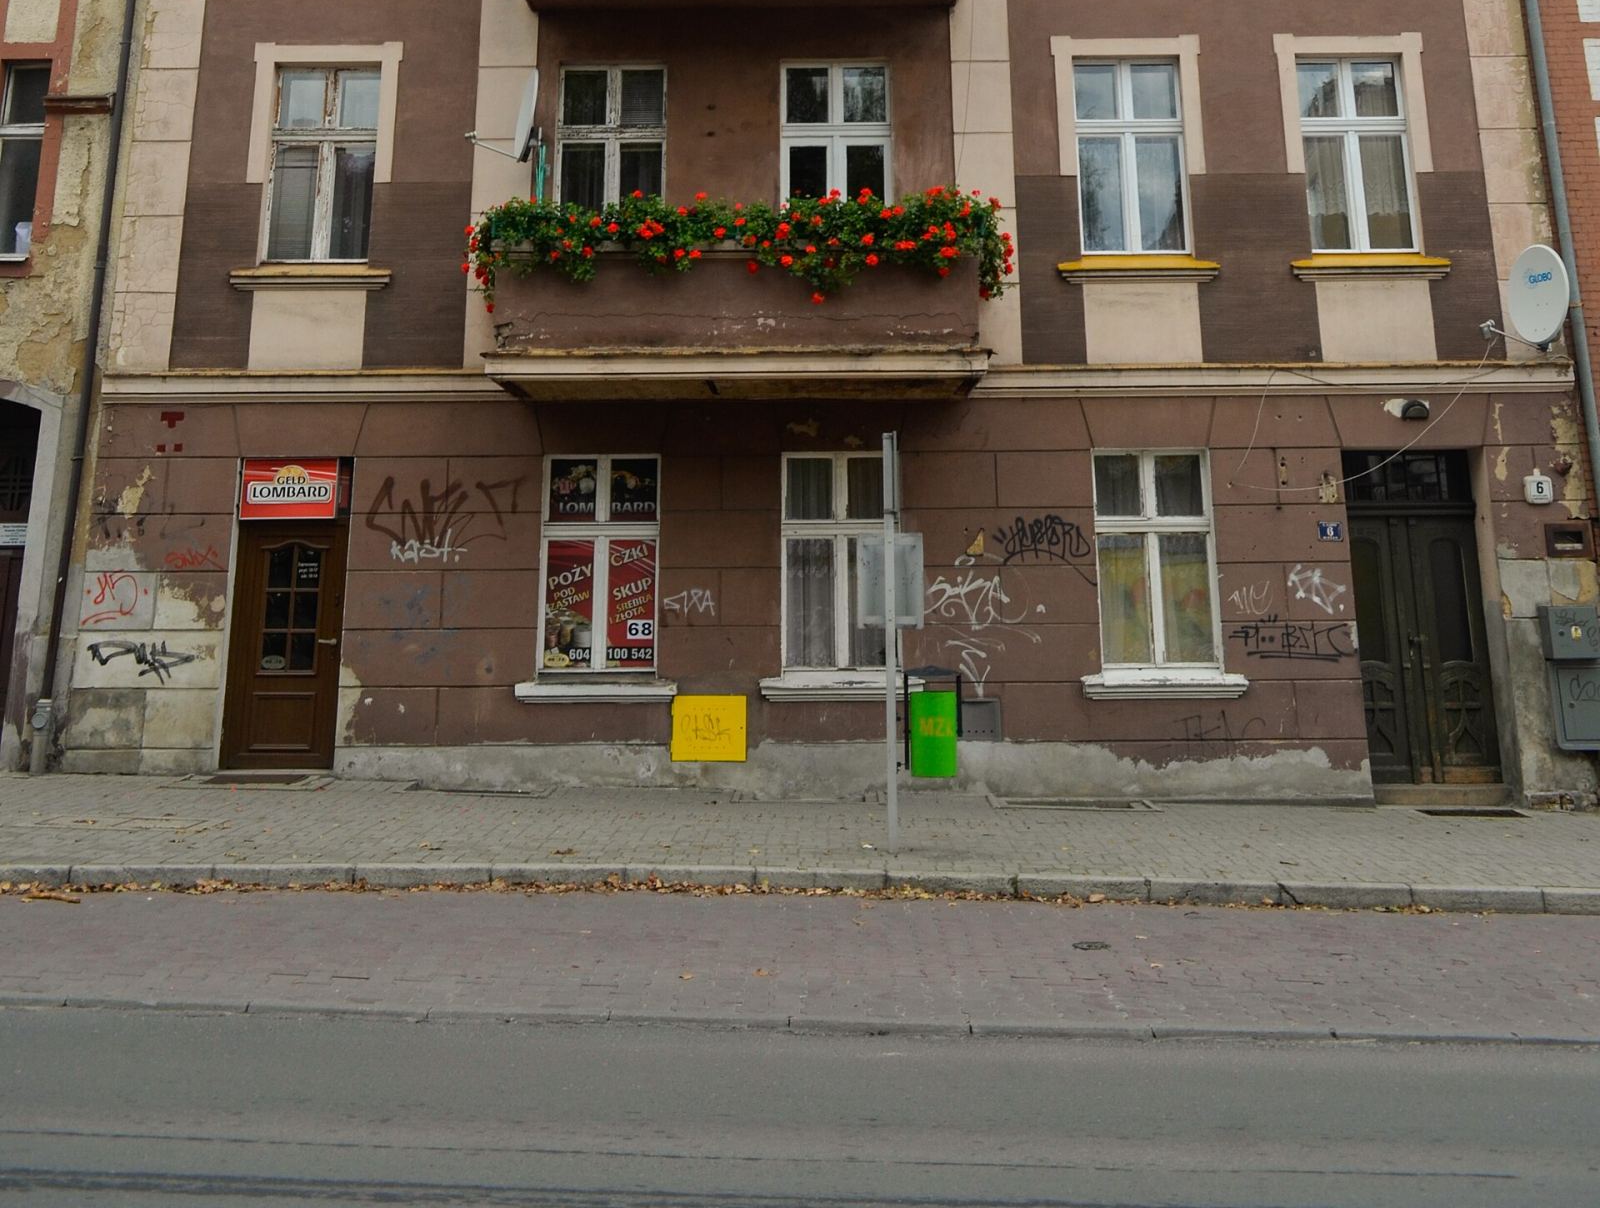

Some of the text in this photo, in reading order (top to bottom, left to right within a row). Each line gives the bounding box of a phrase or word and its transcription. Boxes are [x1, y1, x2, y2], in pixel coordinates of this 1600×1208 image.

[1528, 271, 1553, 284] GLOBO
[276, 476, 306, 485] GELD
[252, 486, 328, 498] LOMBARD
[1536, 481, 1544, 494] 6
[559, 501, 656, 513] LOM BARD
[548, 544, 649, 590] POŻY CZKI
[553, 586, 576, 600] POD
[612, 577, 652, 601] SKUP
[551, 591, 591, 611] ZASTAW
[615, 606, 645, 624] ZŁOTA
[628, 622, 652, 636] 68
[569, 648, 591, 660] 604
[607, 648, 628, 660] 100
[631, 648, 653, 660] 542
